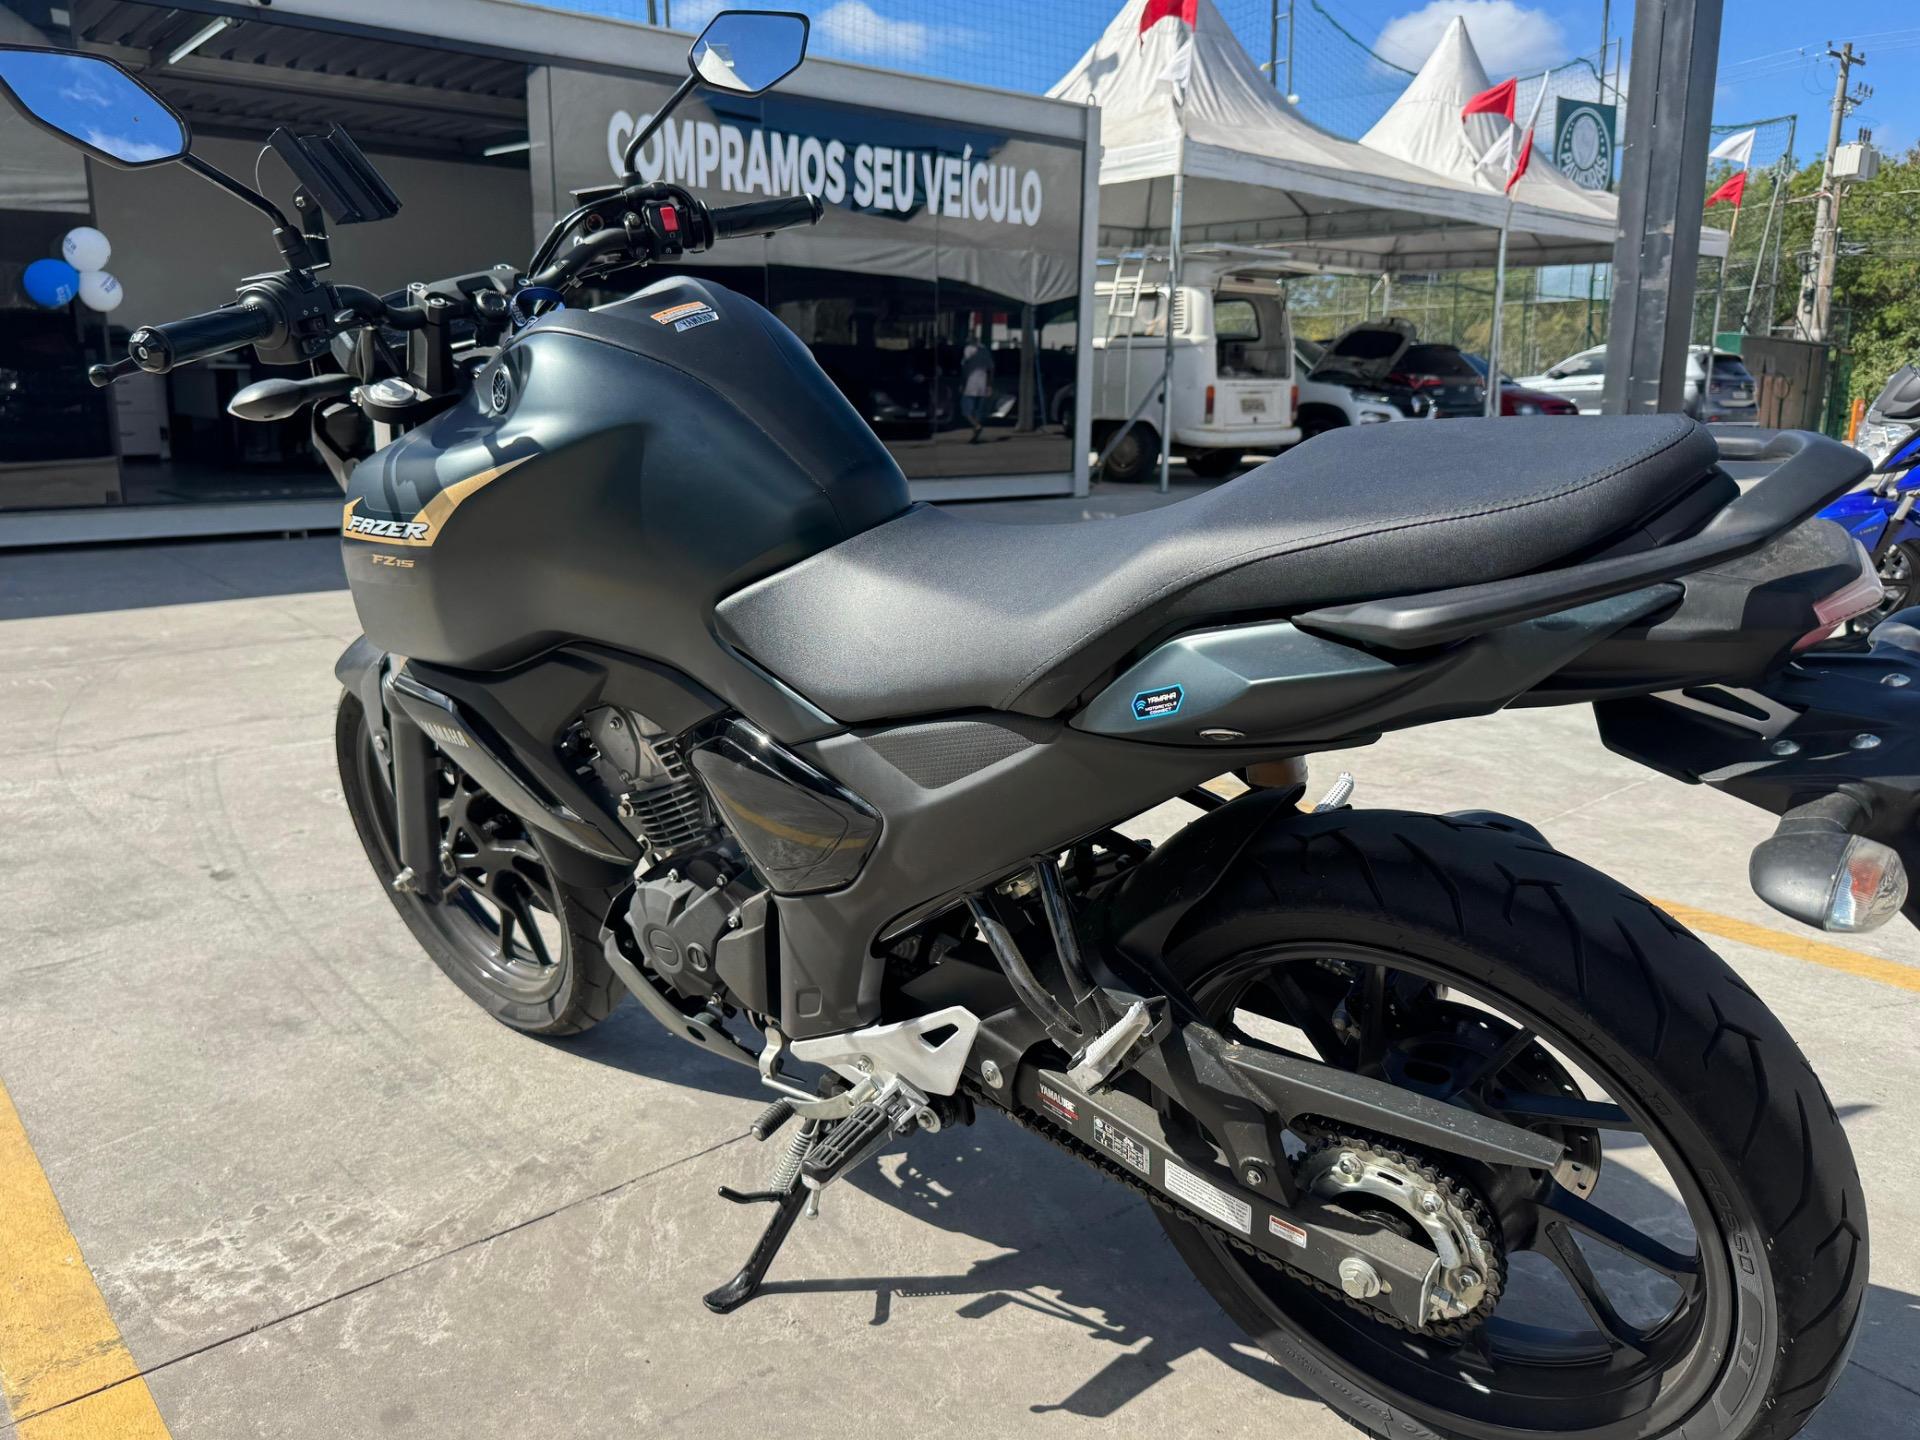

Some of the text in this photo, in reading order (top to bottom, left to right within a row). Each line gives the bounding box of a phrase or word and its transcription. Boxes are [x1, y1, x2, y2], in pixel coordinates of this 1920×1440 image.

[607, 110, 1043, 227] COMPRAMOS SEU VEÍCULO
[346, 513, 430, 540] FAZER
[1147, 691, 1177, 704] YAMAHA
[420, 720, 469, 748] YAMAHA
[1039, 1083, 1076, 1113] YAMALUBE
[1698, 1167, 1756, 1275] ROSSO
